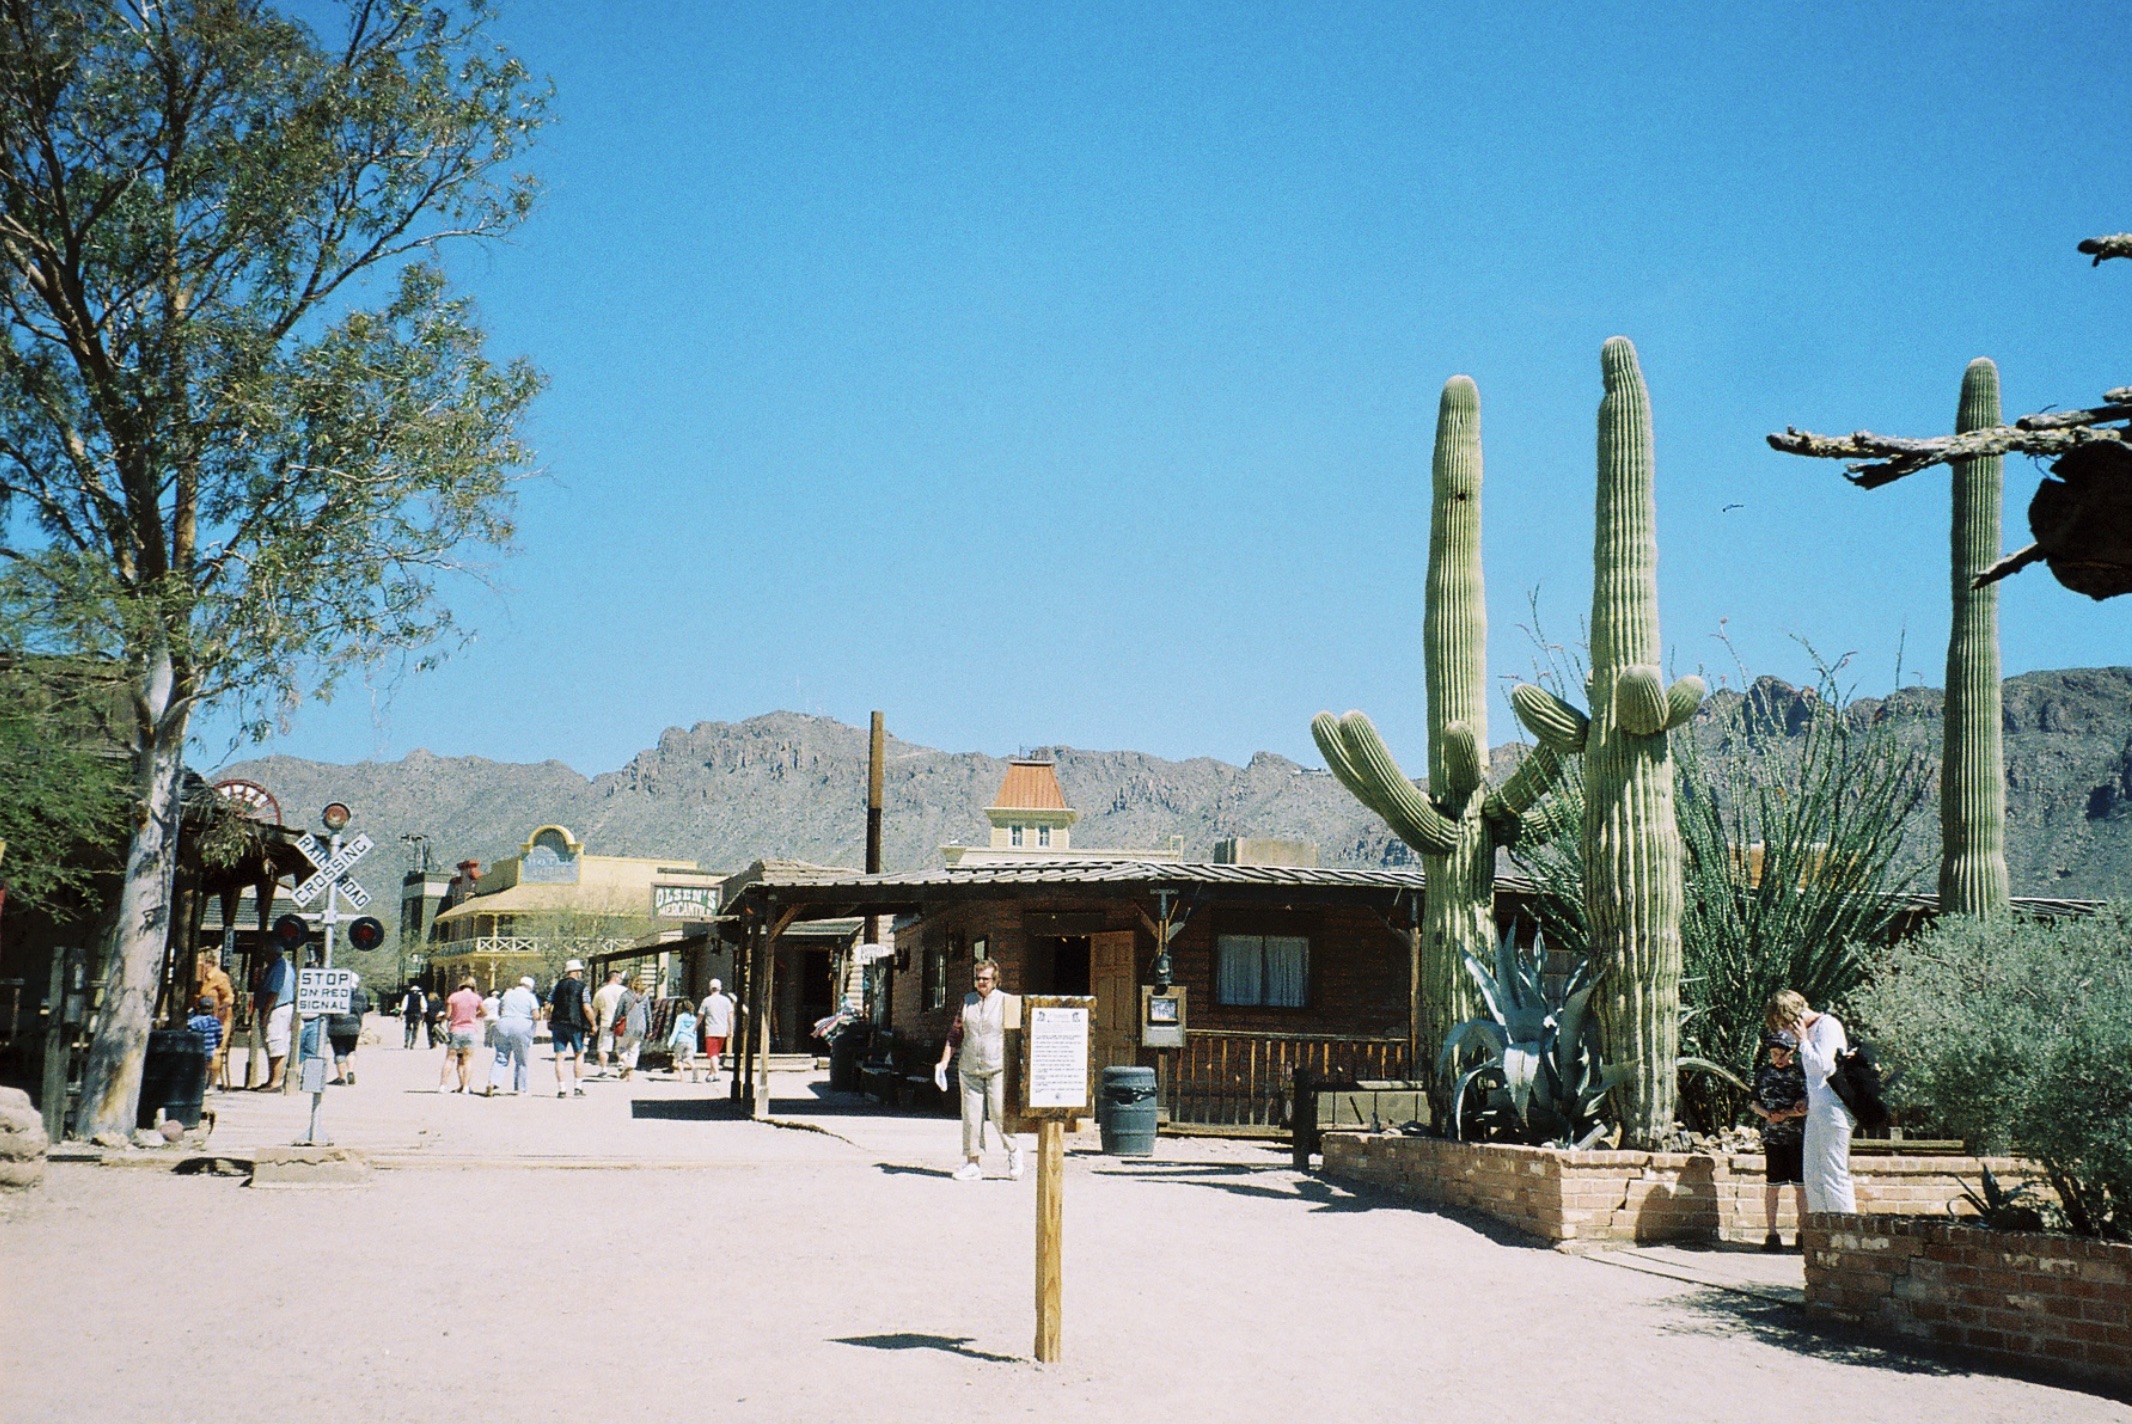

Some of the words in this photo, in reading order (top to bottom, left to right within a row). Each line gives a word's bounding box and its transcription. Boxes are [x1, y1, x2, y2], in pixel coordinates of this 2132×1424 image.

[294, 839, 367, 903] CROSSING
[298, 837, 329, 868] RAIL
[340, 875, 369, 907] ROAD
[656, 887, 717, 910] OLSEN'S
[301, 972, 349, 986] STOP
[299, 987, 318, 997] ON
[321, 988, 349, 998] RED
[299, 1000, 348, 1010] SIGNAL
